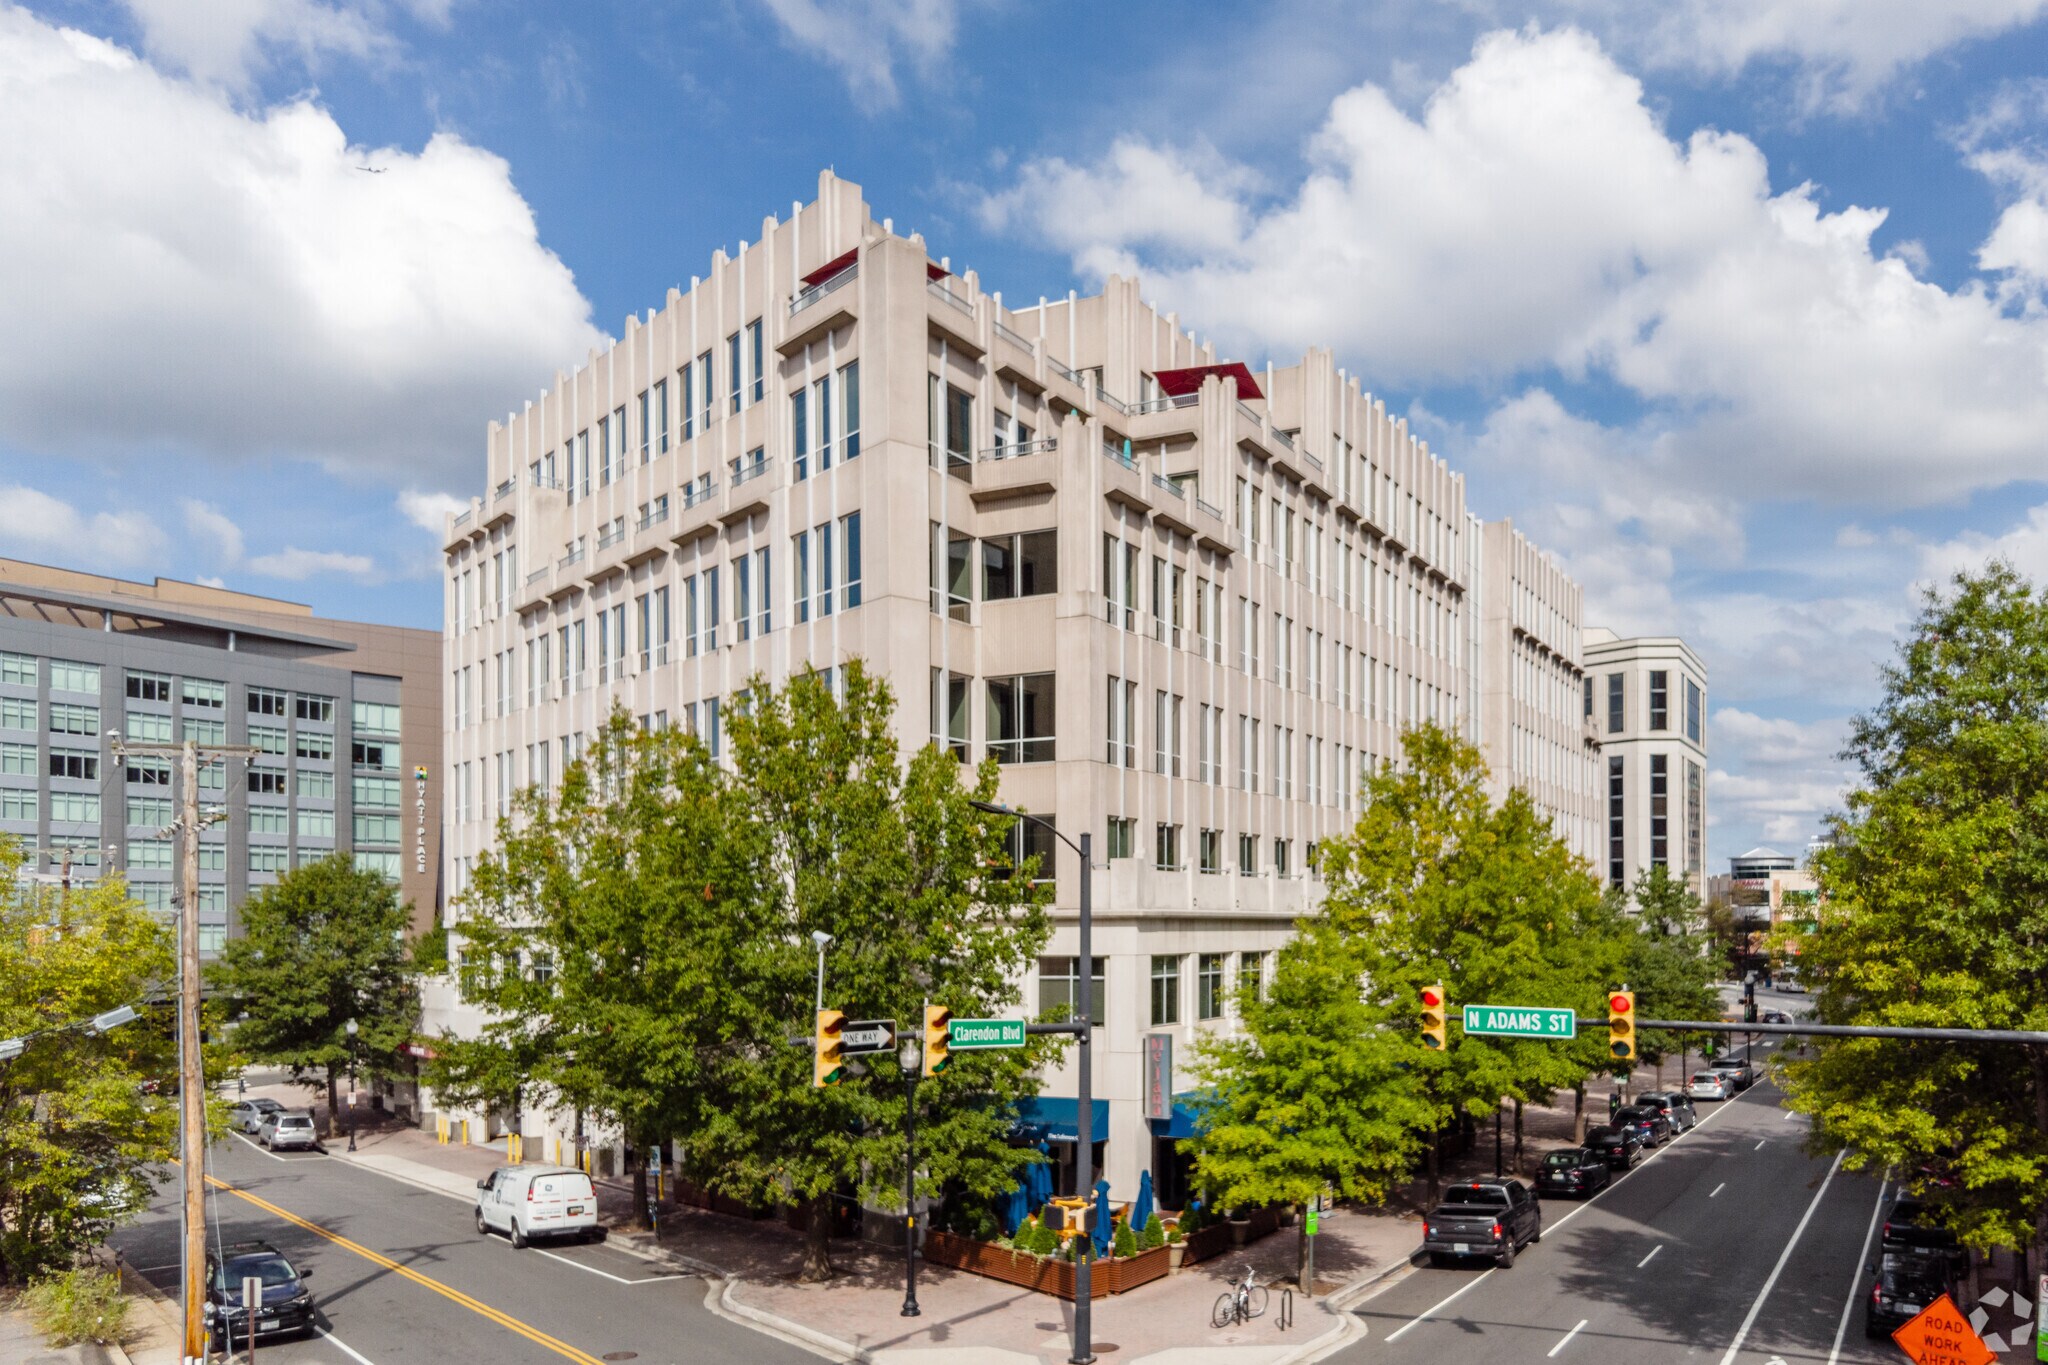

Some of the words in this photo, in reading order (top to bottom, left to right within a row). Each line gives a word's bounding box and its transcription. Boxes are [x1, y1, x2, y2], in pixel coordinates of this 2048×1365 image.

[417, 781, 425, 825] HYATT
[417, 829, 425, 873] PLACE
[1469, 1011, 1479, 1028] N
[1487, 1012, 1541, 1031] ADAMS
[1549, 1014, 1568, 1032] ST
[844, 1033, 859, 1043] ONE
[862, 1031, 878, 1042] WAY
[955, 1026, 999, 1041] Clarendon
[1003, 1026, 1020, 1040] Blvd
[1925, 1316, 1962, 1333] ROAD
[1924, 1334, 1962, 1353] WORK
